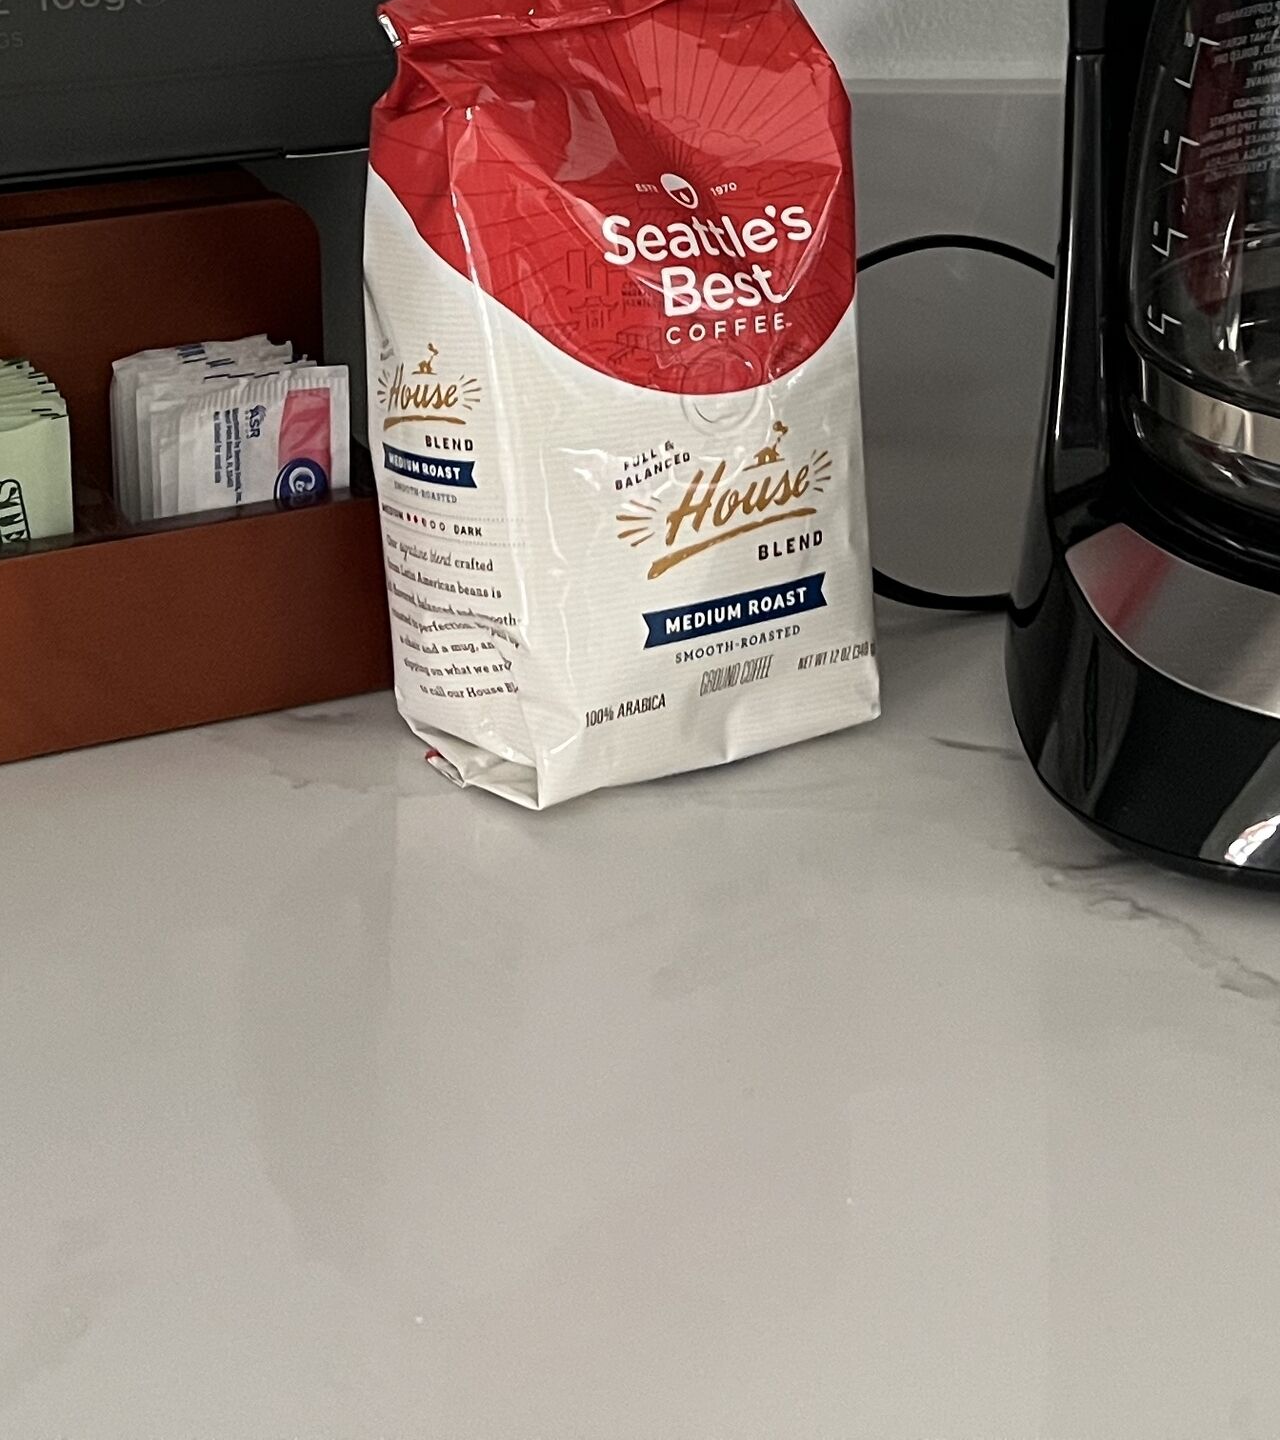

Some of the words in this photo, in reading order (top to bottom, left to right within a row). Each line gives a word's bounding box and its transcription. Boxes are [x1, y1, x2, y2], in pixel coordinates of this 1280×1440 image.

[710, 181, 738, 197] 1970
[601, 204, 813, 266] Seattle's
[660, 263, 785, 317] Best
[665, 312, 785, 345] COFFEE
[388, 362, 459, 413] House
[425, 434, 474, 451] BLEND
[422, 462, 461, 481] ROAST
[614, 452, 690, 491] BALANCED
[665, 460, 811, 547] House
[453, 524, 483, 538] DARK
[758, 529, 823, 561] BLEND
[456, 580, 489, 598] beans
[665, 602, 742, 636] MEDIUM
[748, 586, 807, 617] ROAST
[675, 624, 801, 665] SMOOTH-ROASTED
[466, 685, 505, 698] House
[584, 705, 614, 728] 100%
[617, 693, 667, 719] ARABICA
